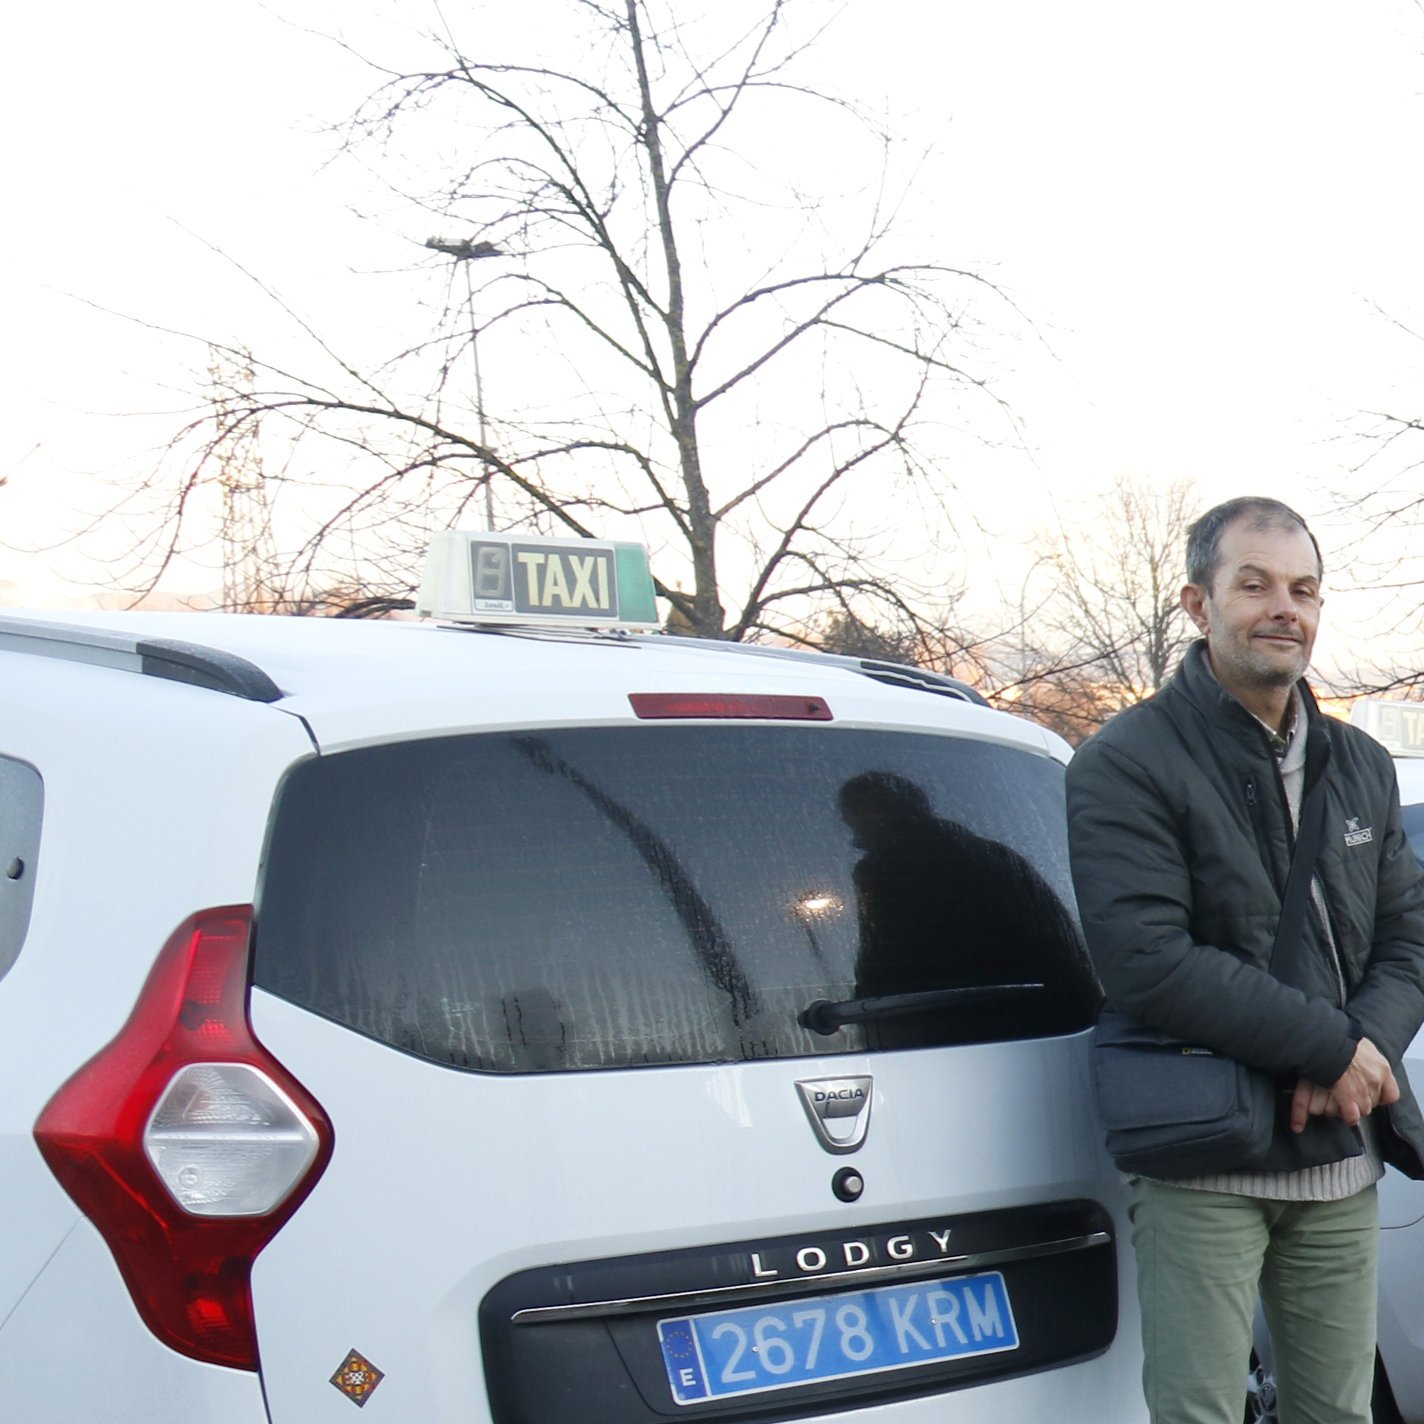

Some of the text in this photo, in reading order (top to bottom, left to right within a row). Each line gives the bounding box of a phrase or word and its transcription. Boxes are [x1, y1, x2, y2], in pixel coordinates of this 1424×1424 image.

[517, 551, 609, 610] TAXI
[814, 1087, 866, 1102] DACIA
[751, 1229, 951, 1278] LODGY
[679, 1283, 1005, 1387] E 2678 KRM
